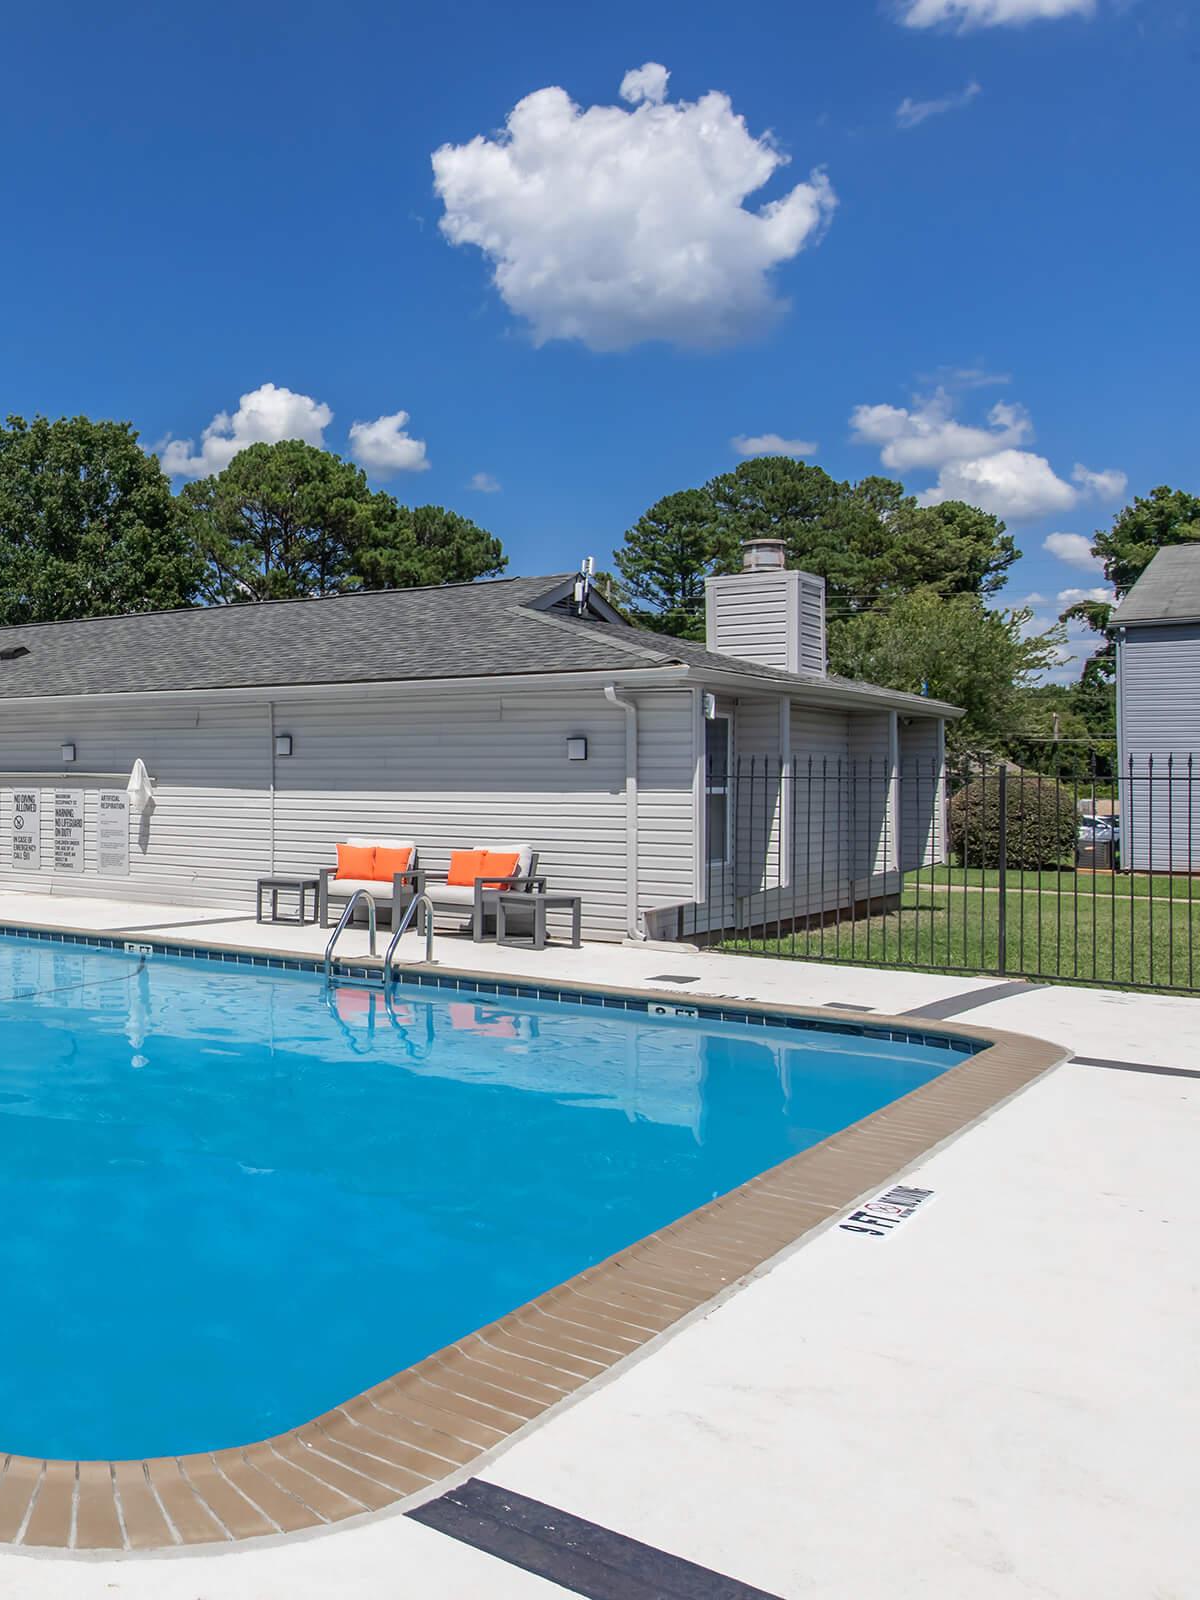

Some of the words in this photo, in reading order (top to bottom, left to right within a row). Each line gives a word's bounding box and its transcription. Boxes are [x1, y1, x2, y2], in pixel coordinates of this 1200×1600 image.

[21, 794, 36, 803] DIVING
[16, 803, 37, 812] ALLOWED
[62, 818, 82, 828] LIFEGUARD
[62, 828, 72, 837] DUTY
[13, 844, 37, 852] EMERGENCY
[847, 1210, 901, 1228] FT
[838, 1224, 885, 1236] 9
